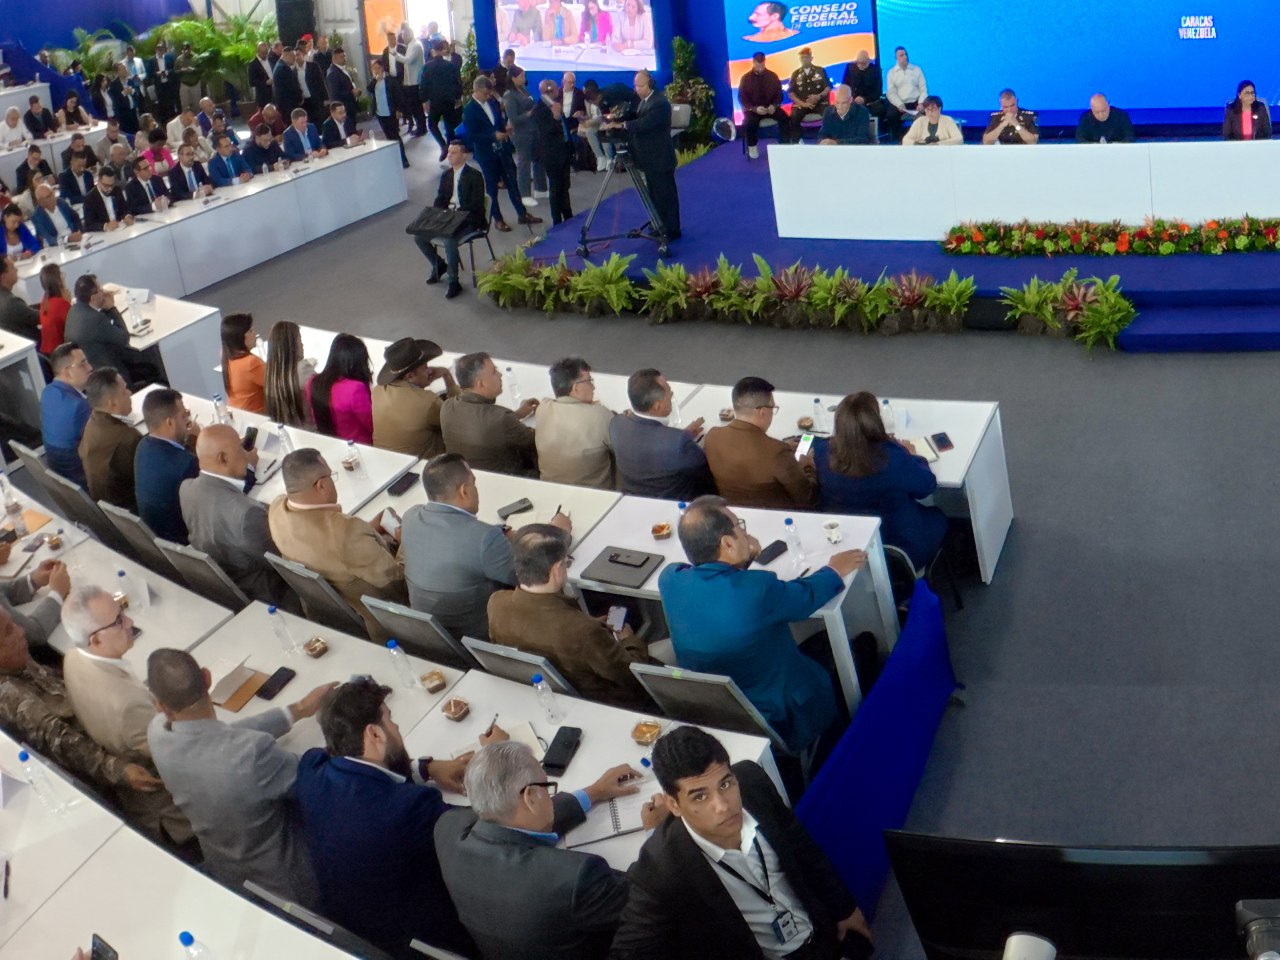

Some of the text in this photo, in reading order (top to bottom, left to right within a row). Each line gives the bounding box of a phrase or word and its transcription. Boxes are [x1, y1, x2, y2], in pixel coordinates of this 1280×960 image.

[789, 2, 858, 15] CONSEJO
[790, 11, 858, 24] FEDERAL
[805, 18, 859, 28] GOBIERNO
[1181, 16, 1214, 27] CARACAS
[1179, 27, 1217, 39] VENEZUELA
